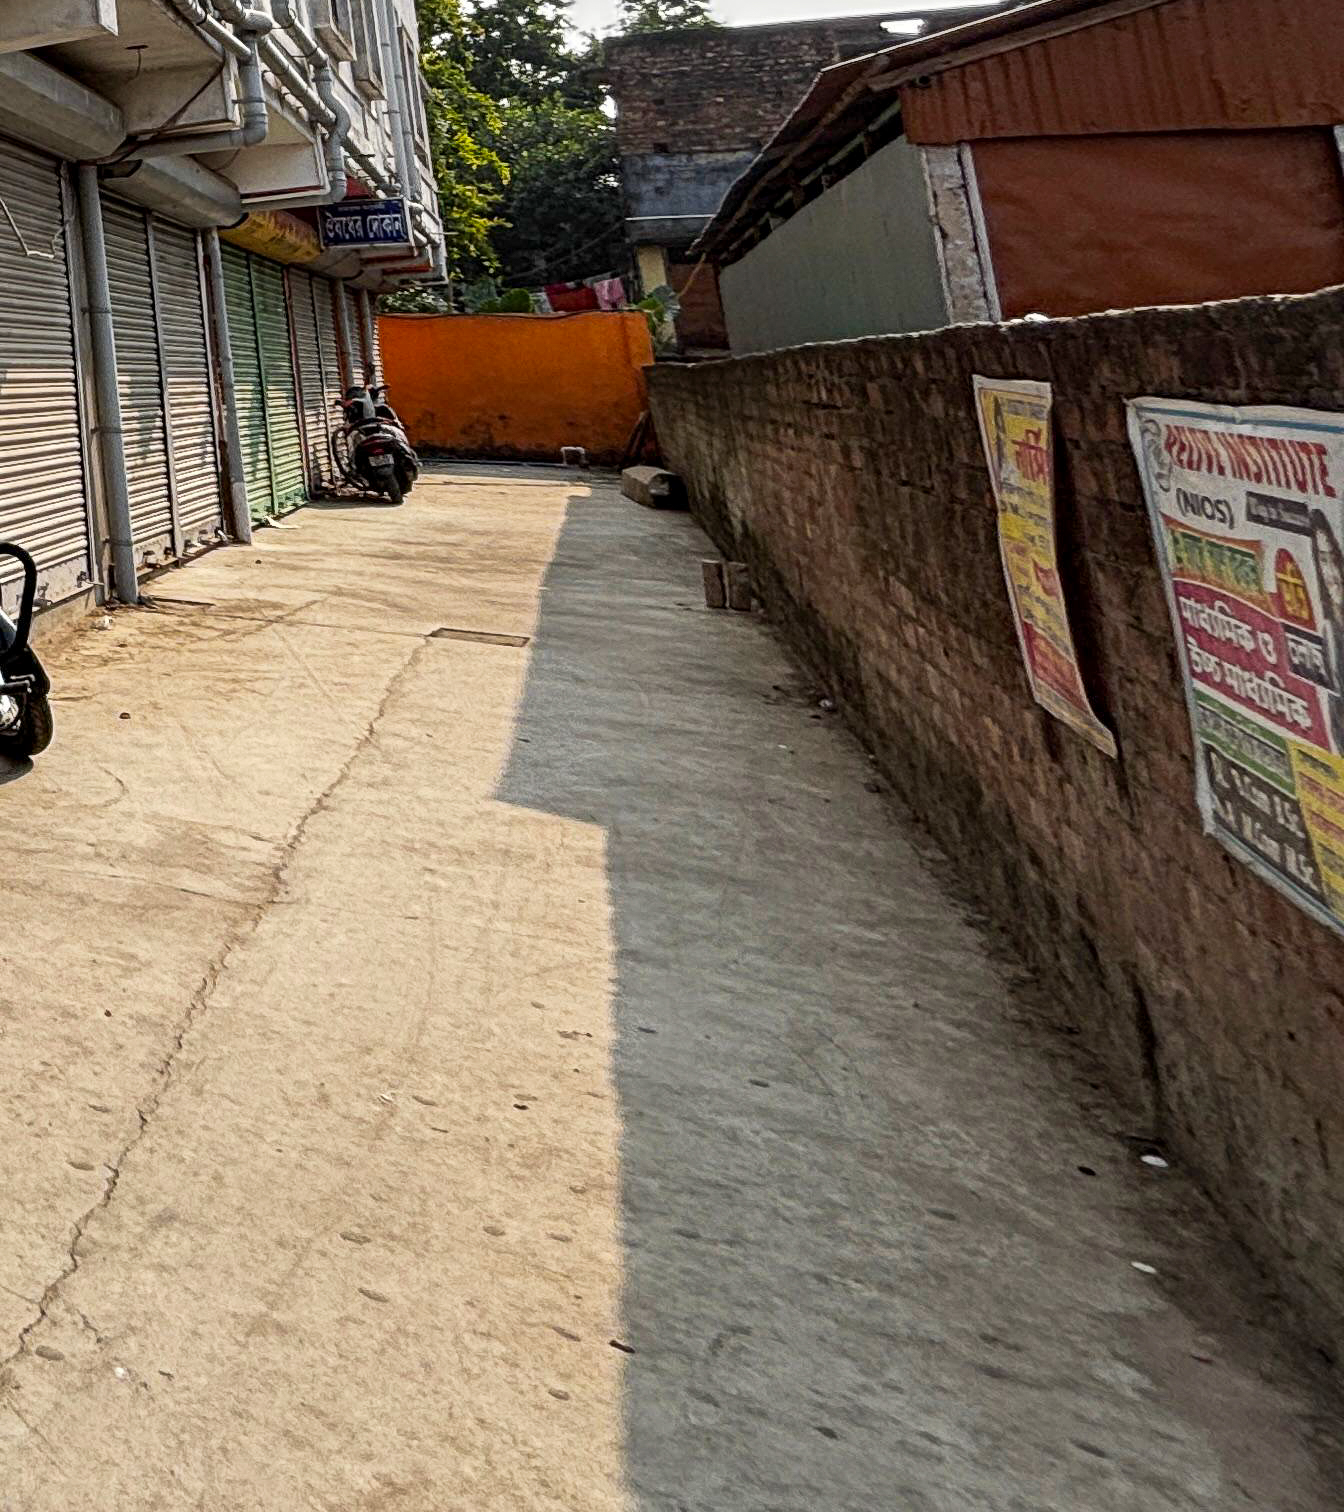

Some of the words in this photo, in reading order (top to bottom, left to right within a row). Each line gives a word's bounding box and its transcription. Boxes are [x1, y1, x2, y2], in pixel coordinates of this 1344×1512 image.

[1217, 430, 1338, 499] INSTITUTE
[1175, 487, 1235, 530] (NIOS)
[1178, 595, 1256, 654] মাধ্যমিক
[1257, 631, 1278, 665] ও
[1224, 669, 1312, 732] মাধ্যমিক
